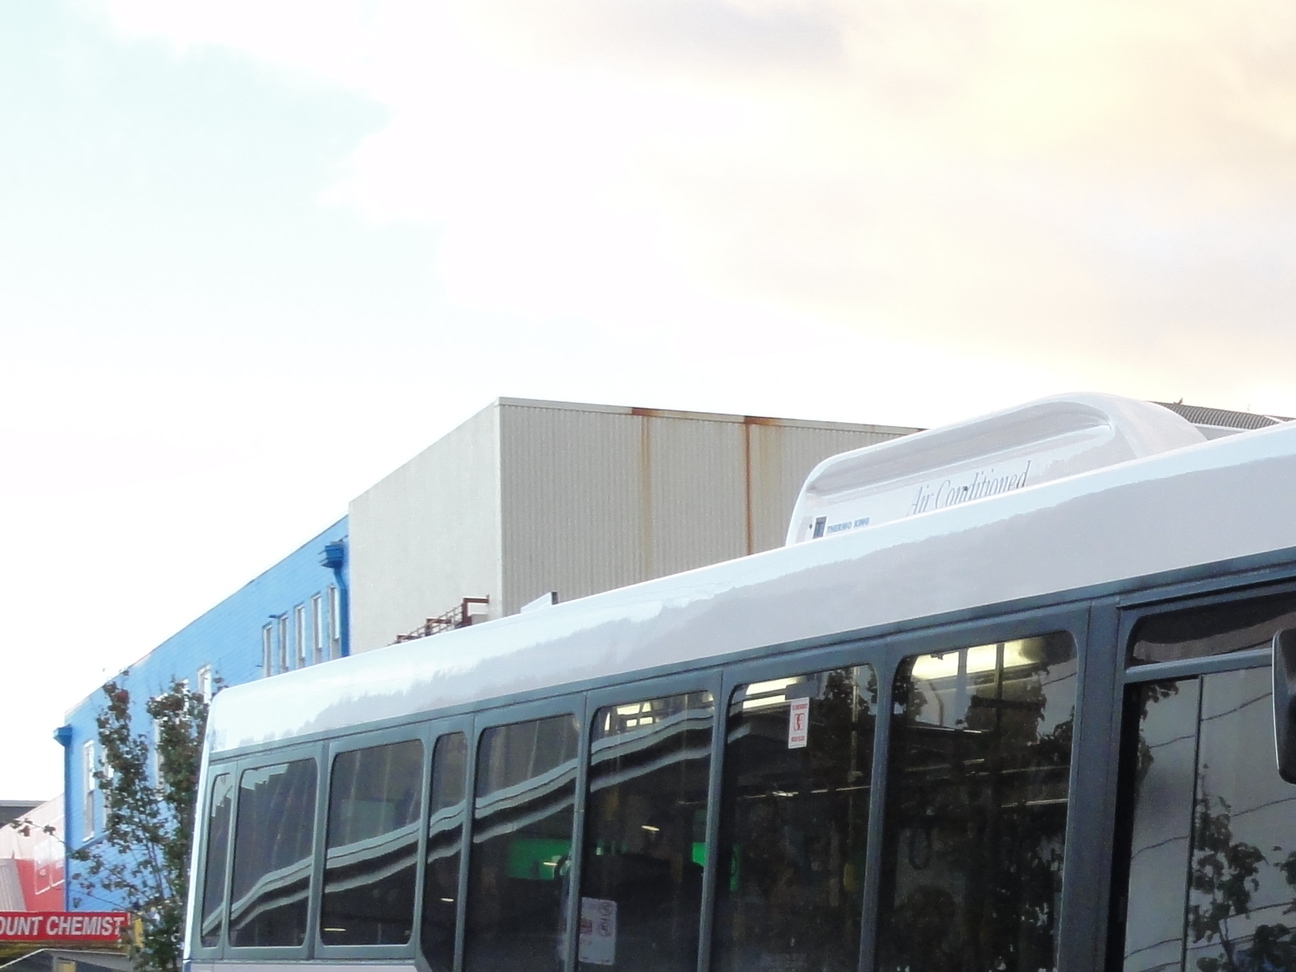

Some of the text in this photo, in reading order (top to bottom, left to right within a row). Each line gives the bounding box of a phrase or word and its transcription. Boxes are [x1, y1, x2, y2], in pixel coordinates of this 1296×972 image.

[907, 460, 1032, 516] Air Conditioned
[46, 915, 125, 936] CHEMIST
